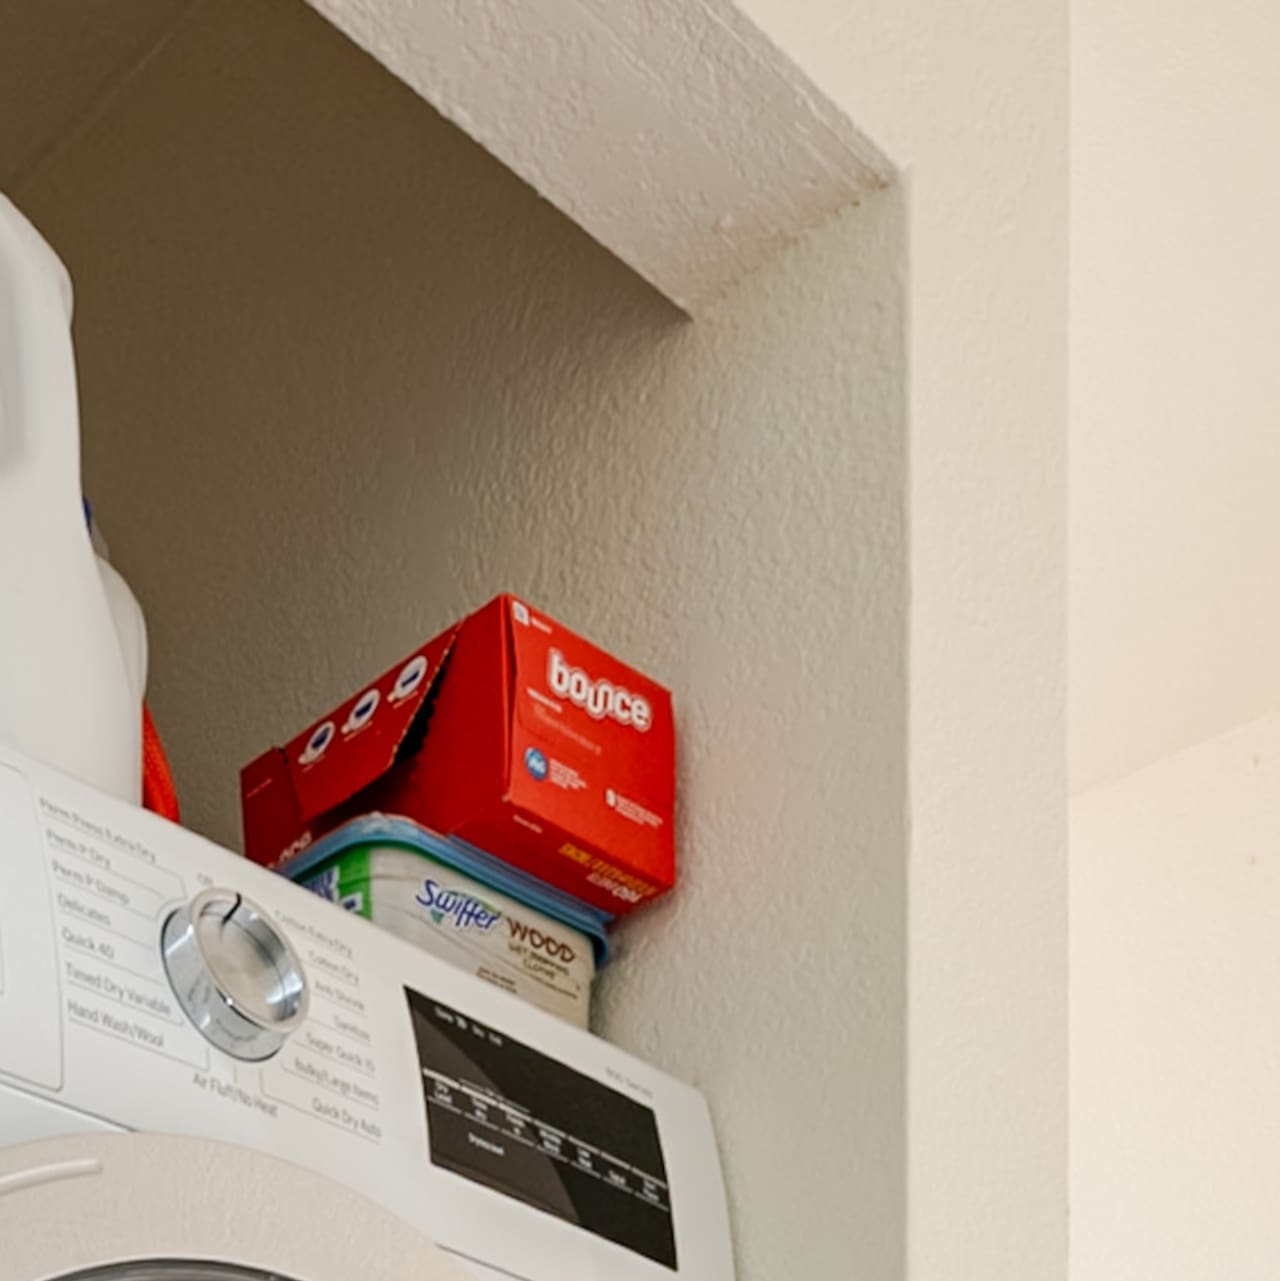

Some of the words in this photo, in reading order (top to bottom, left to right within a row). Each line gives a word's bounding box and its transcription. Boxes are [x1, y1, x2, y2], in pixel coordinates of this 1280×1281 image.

[549, 647, 651, 733] bounce
[415, 879, 503, 930] Swiffer
[507, 916, 576, 963] WOOD
[67, 999, 99, 1024] Hand
